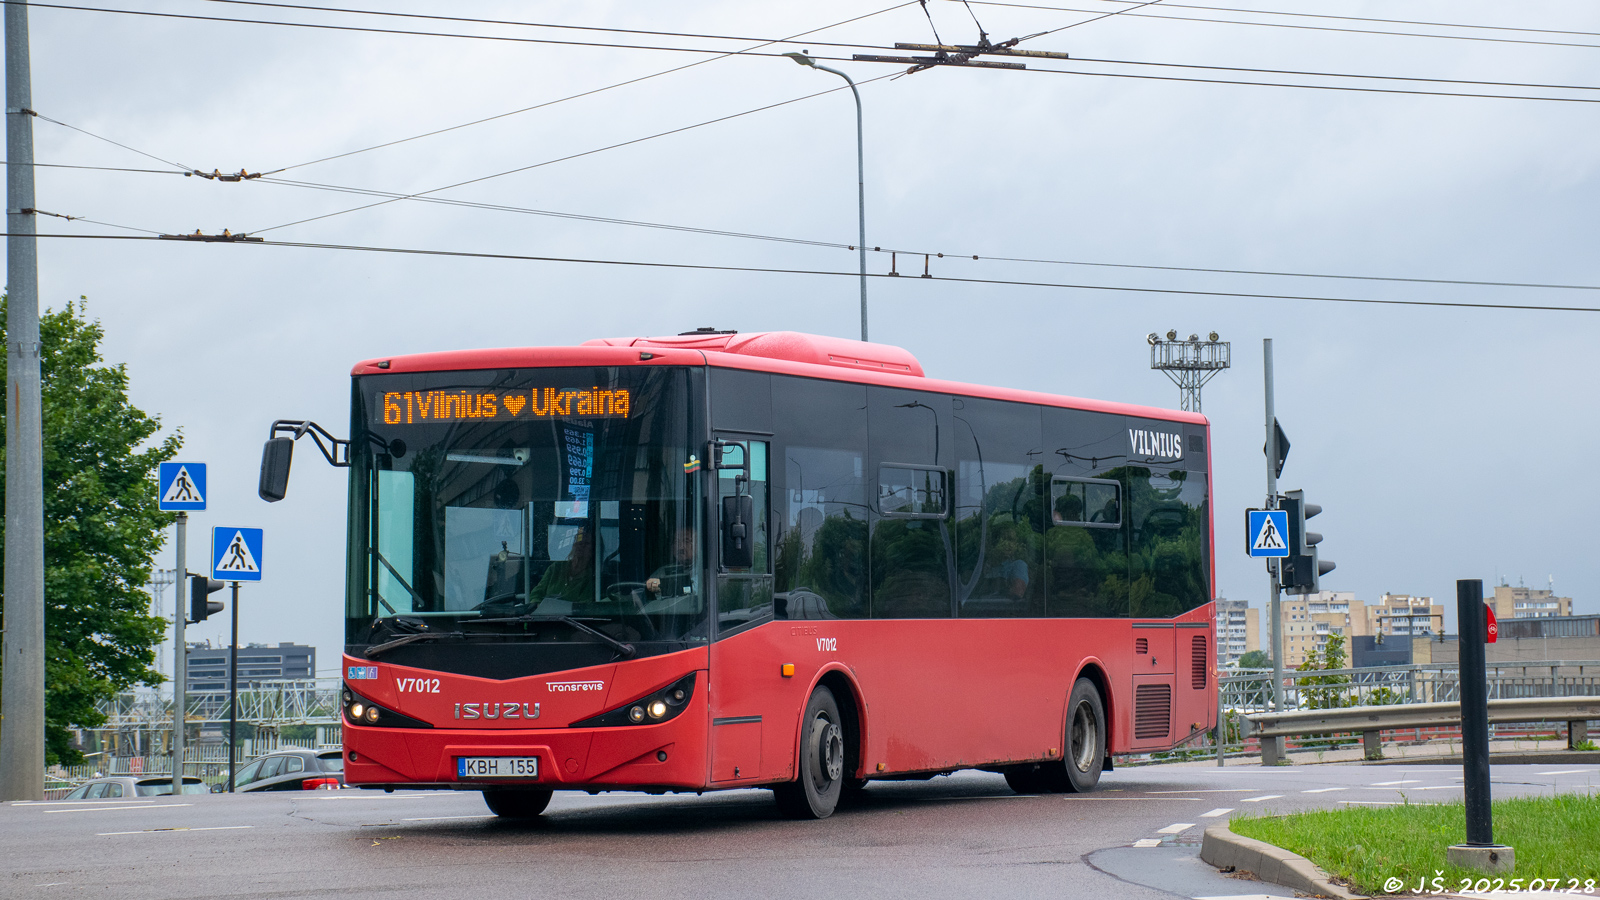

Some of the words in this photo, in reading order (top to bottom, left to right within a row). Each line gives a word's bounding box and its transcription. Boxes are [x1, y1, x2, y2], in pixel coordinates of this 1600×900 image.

[384, 391, 413, 424] 61
[414, 390, 498, 419] Vilnius
[532, 386, 630, 418] Ukrainą
[1128, 428, 1182, 459] VILNIUS
[816, 638, 837, 651] V7012
[396, 678, 440, 693] V7012
[546, 681, 604, 692] Transrevis
[454, 703, 540, 719] ISUZU
[467, 760, 498, 774] KBH
[510, 760, 535, 774] 155
